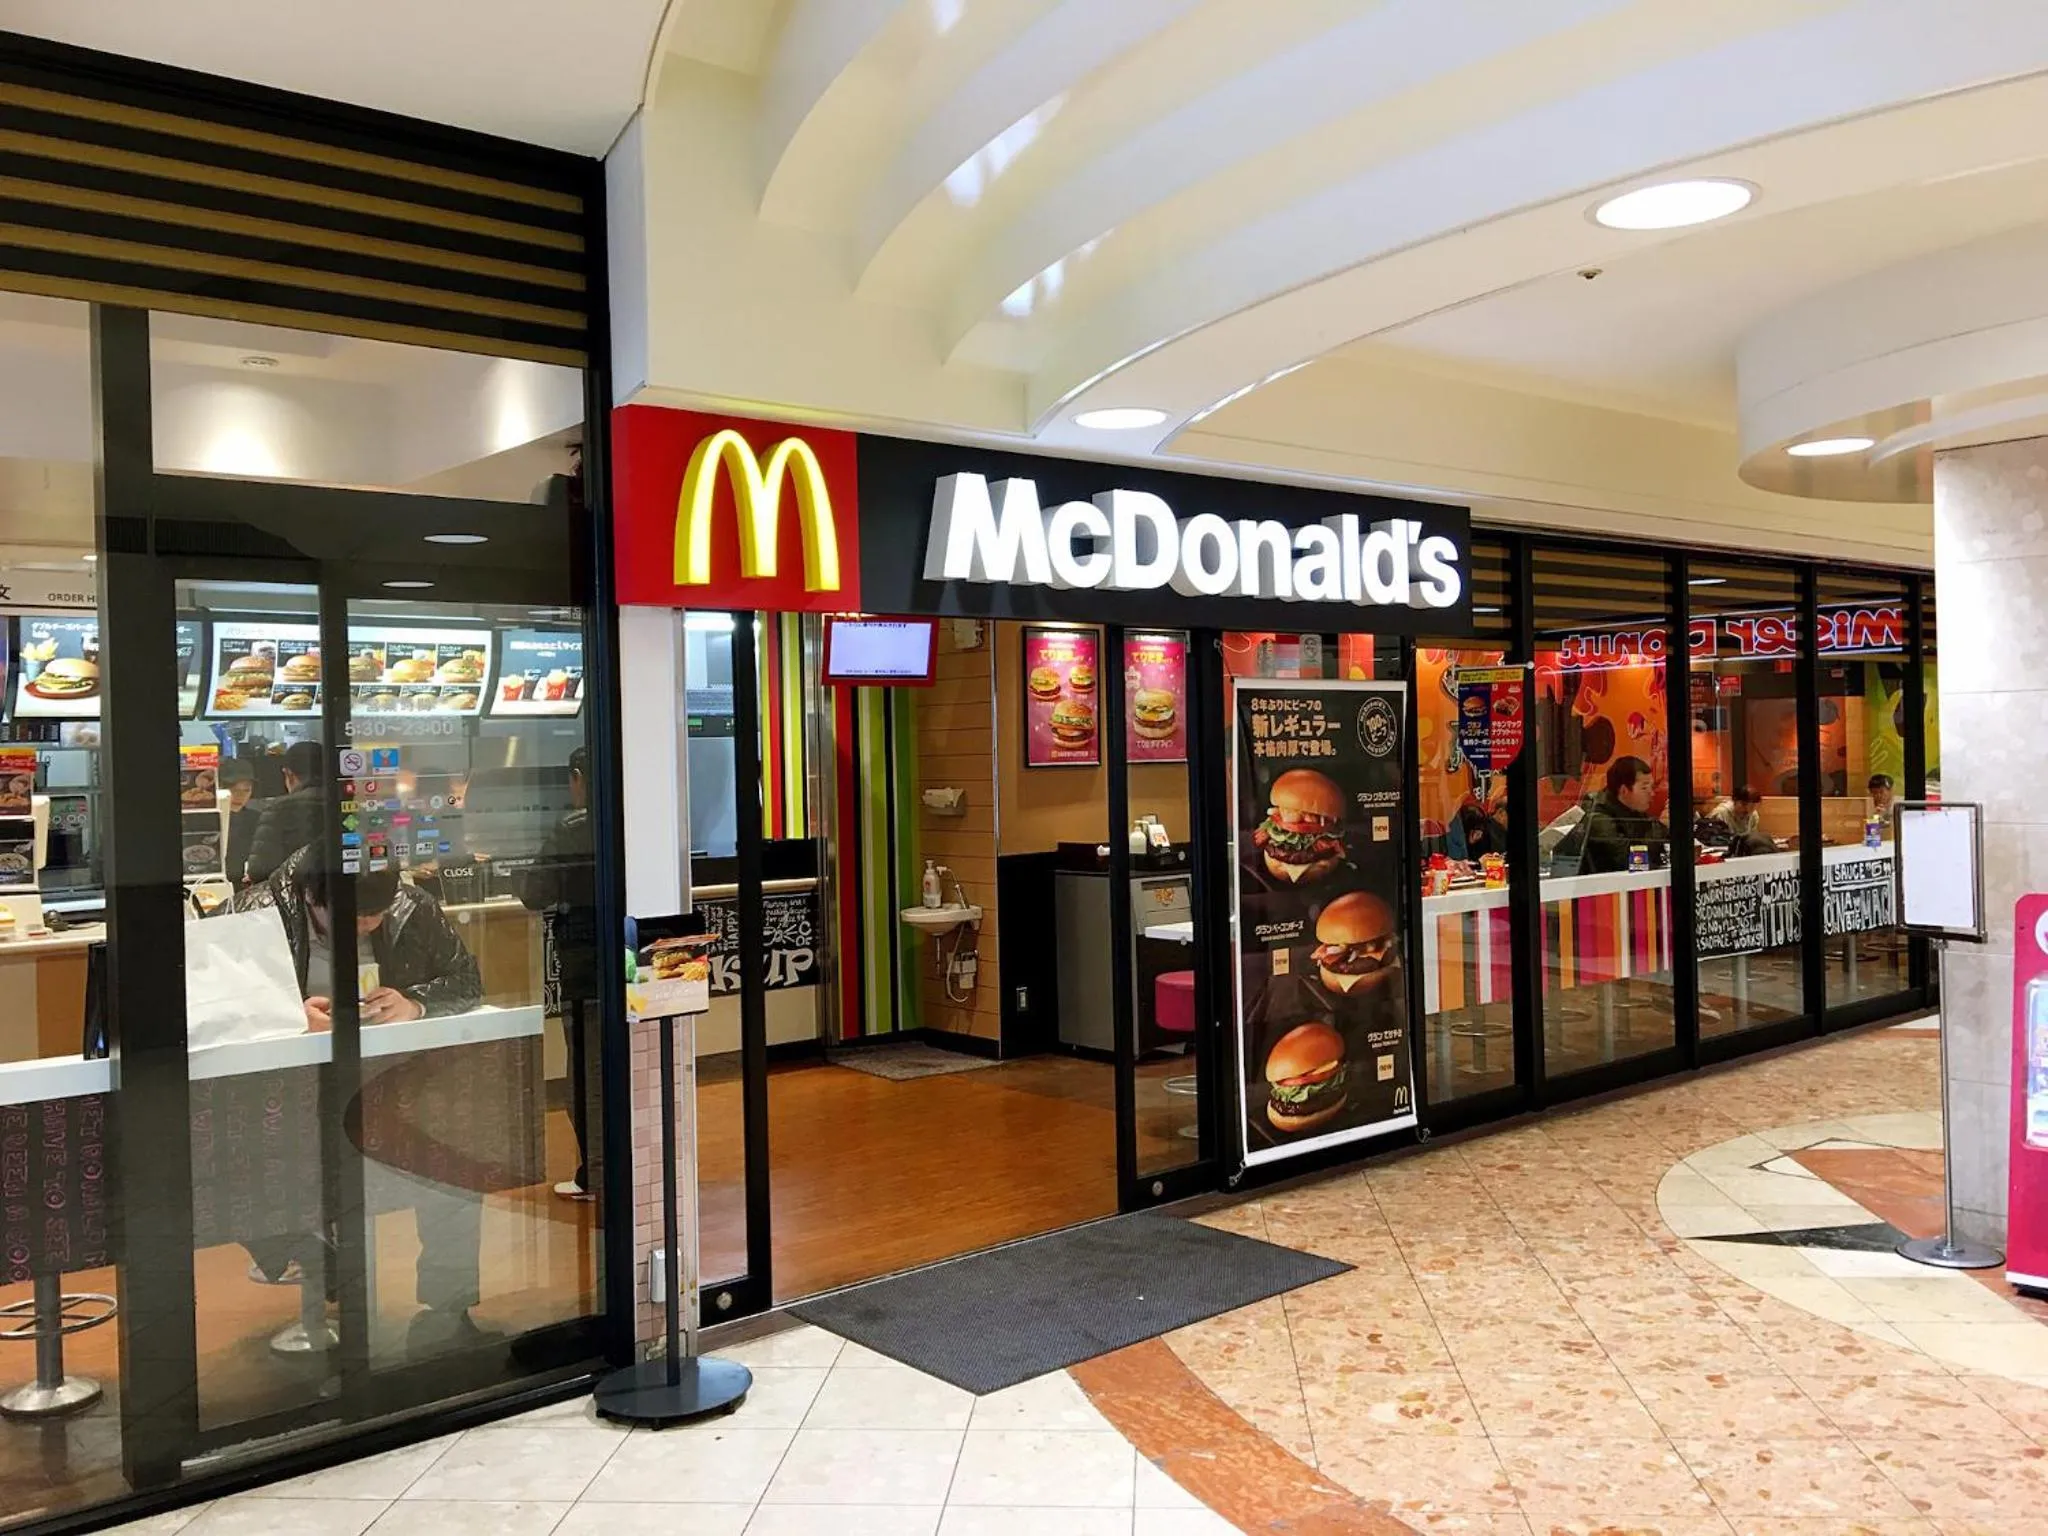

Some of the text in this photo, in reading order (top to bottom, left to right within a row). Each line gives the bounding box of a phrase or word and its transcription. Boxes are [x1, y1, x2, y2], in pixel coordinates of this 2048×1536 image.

[926, 470, 1462, 609] McDonald's
[48, 593, 84, 602] ORDER
[1251, 698, 1322, 712] 8年ぶりにビーフの
[1252, 714, 1341, 738] 新レギュラー
[443, 868, 473, 878] CLOSE
[1835, 863, 1866, 881] SAUCE
[727, 910, 740, 950] HAPPY
